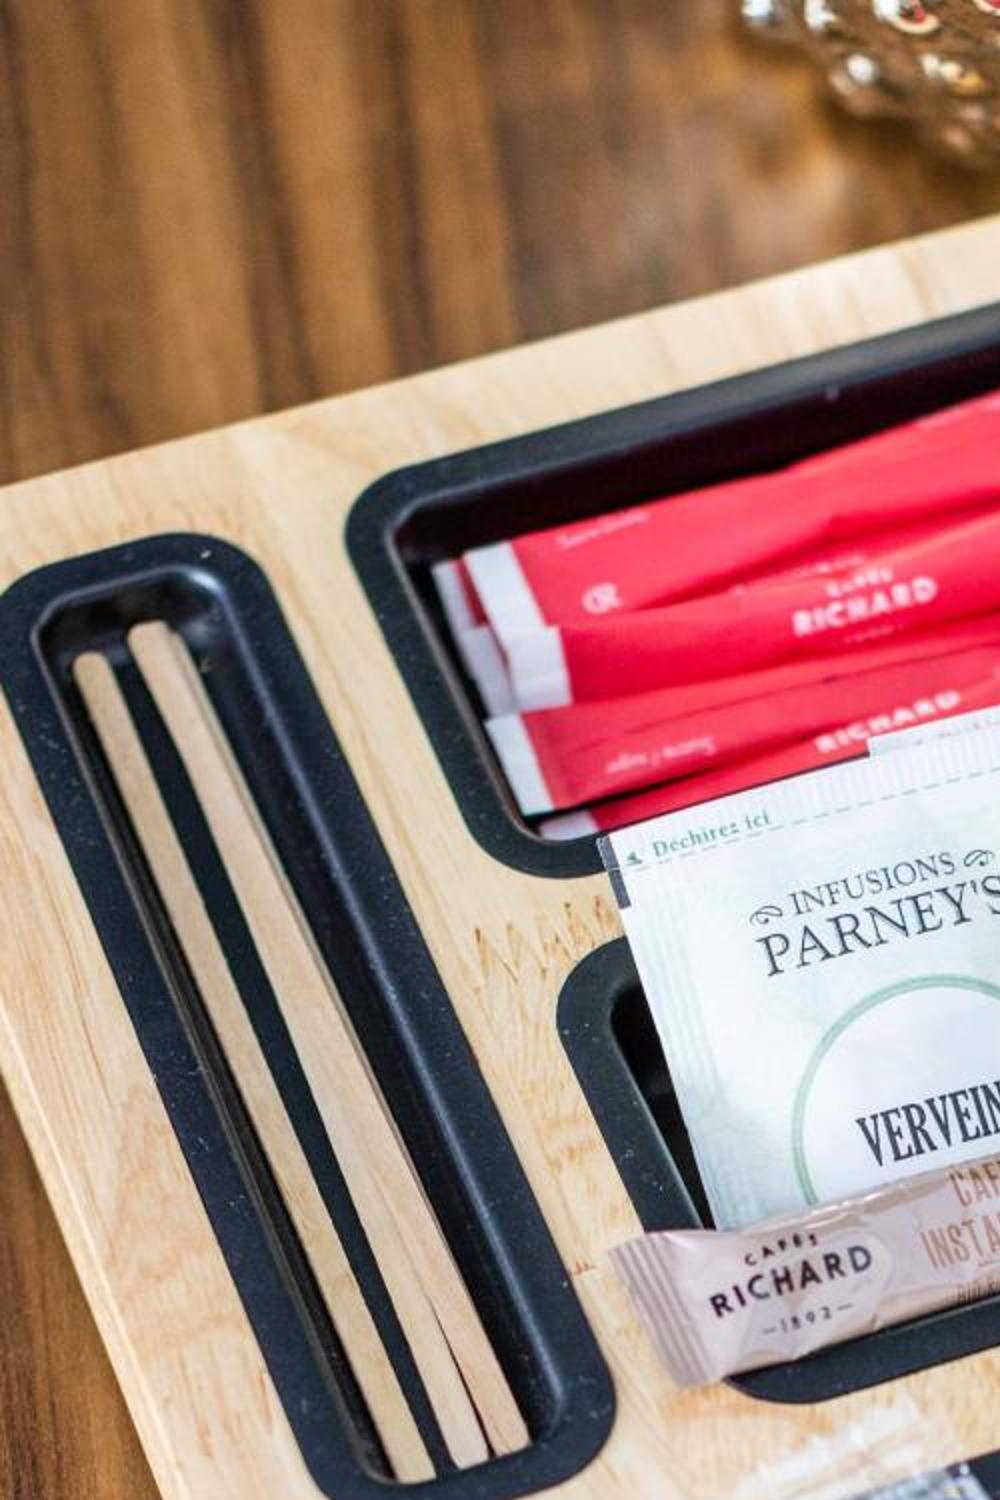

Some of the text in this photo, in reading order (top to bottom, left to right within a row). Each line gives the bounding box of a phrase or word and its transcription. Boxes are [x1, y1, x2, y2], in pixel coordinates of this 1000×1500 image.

[792, 575, 938, 638] RICHARD
[815, 690, 961, 753] RICHARD
[790, 852, 956, 916] INFUSIONS
[708, 1245, 873, 1319] RICHARD
